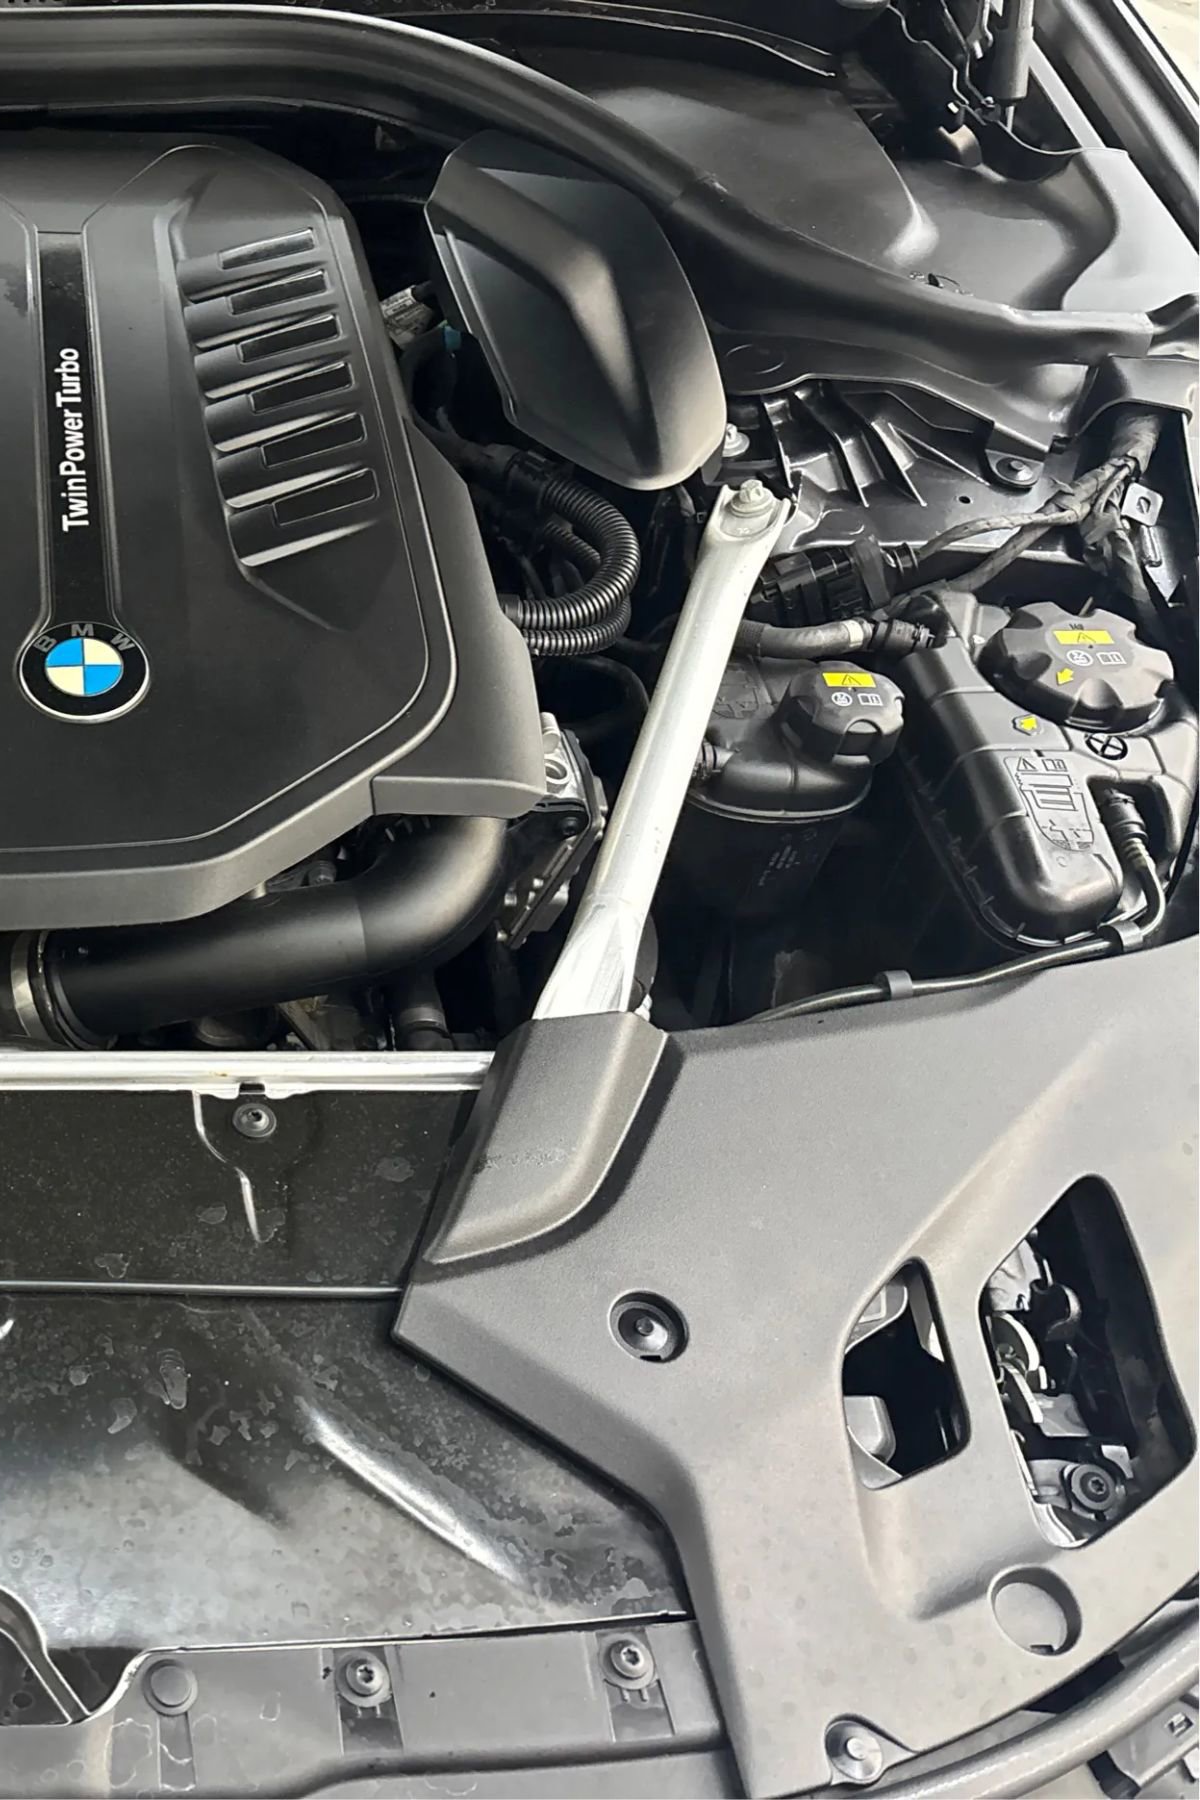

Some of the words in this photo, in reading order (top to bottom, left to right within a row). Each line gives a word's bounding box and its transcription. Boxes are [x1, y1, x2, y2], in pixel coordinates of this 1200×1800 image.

[54, 347, 82, 408] Turbo
[59, 408, 90, 532] TwinPower
[33, 623, 136, 653] BMW
